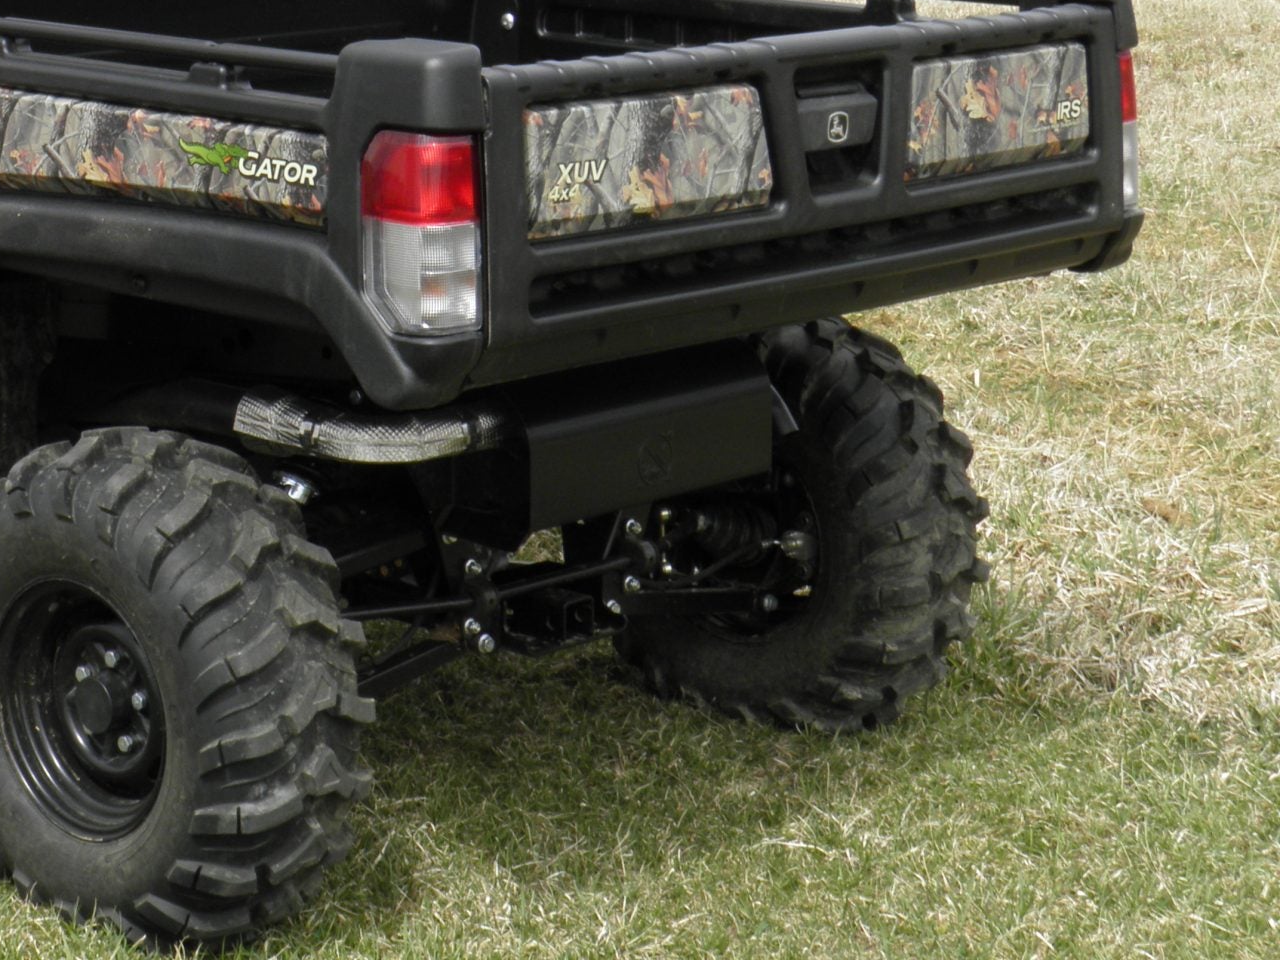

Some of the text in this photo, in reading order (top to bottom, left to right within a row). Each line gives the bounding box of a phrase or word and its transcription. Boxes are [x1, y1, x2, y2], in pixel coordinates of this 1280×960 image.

[1057, 99, 1081, 121] IRS
[238, 151, 318, 186] GATOR
[557, 159, 607, 185] XUV
[548, 184, 580, 202] 4x4
